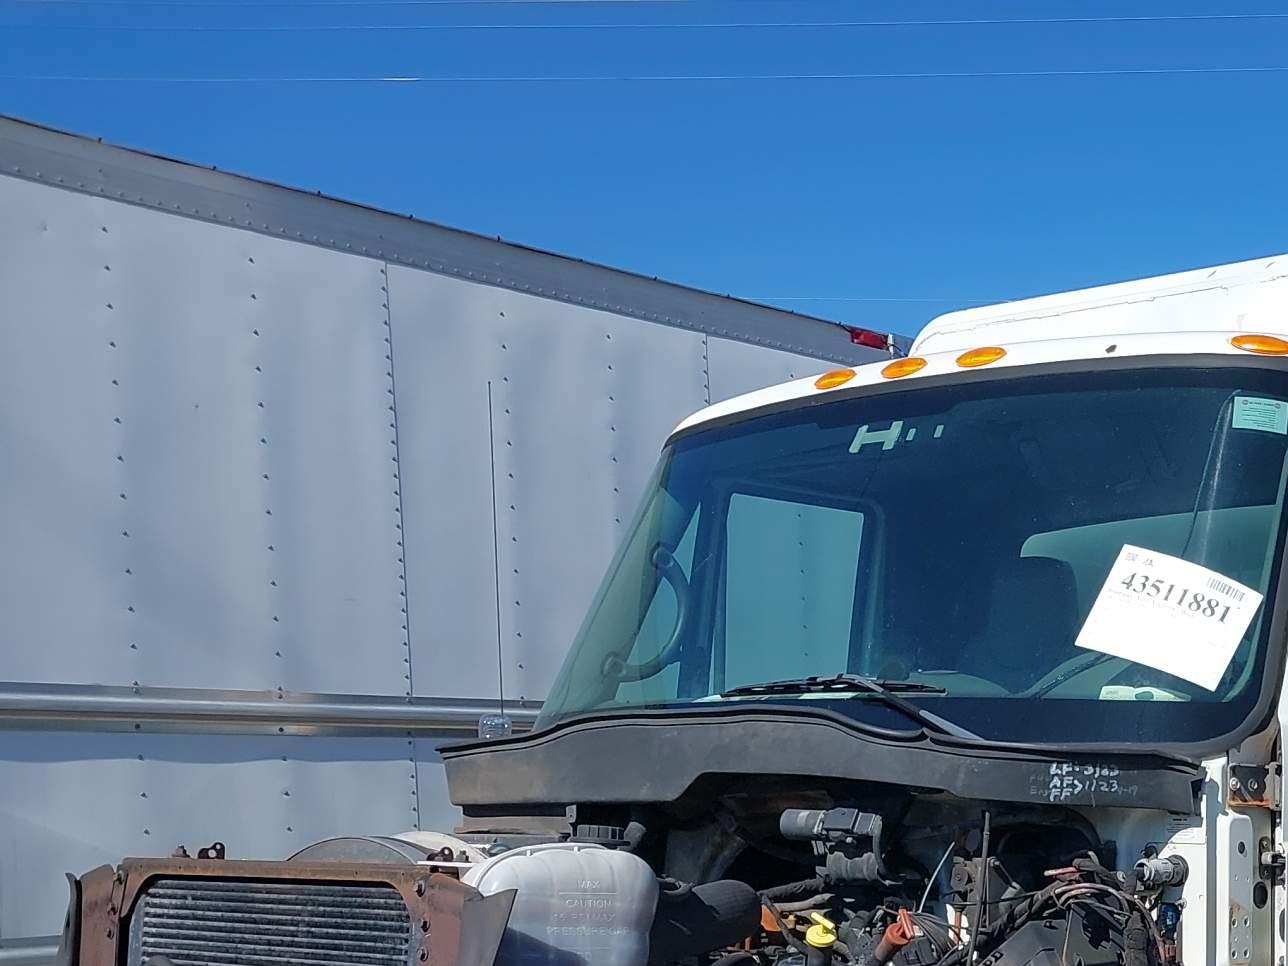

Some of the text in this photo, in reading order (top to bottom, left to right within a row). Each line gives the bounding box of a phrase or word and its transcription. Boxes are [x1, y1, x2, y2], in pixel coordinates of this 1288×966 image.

[1120, 571, 1232, 625] 43511881
[577, 879, 601, 889] MAX
[565, 898, 613, 909] CAUTION
